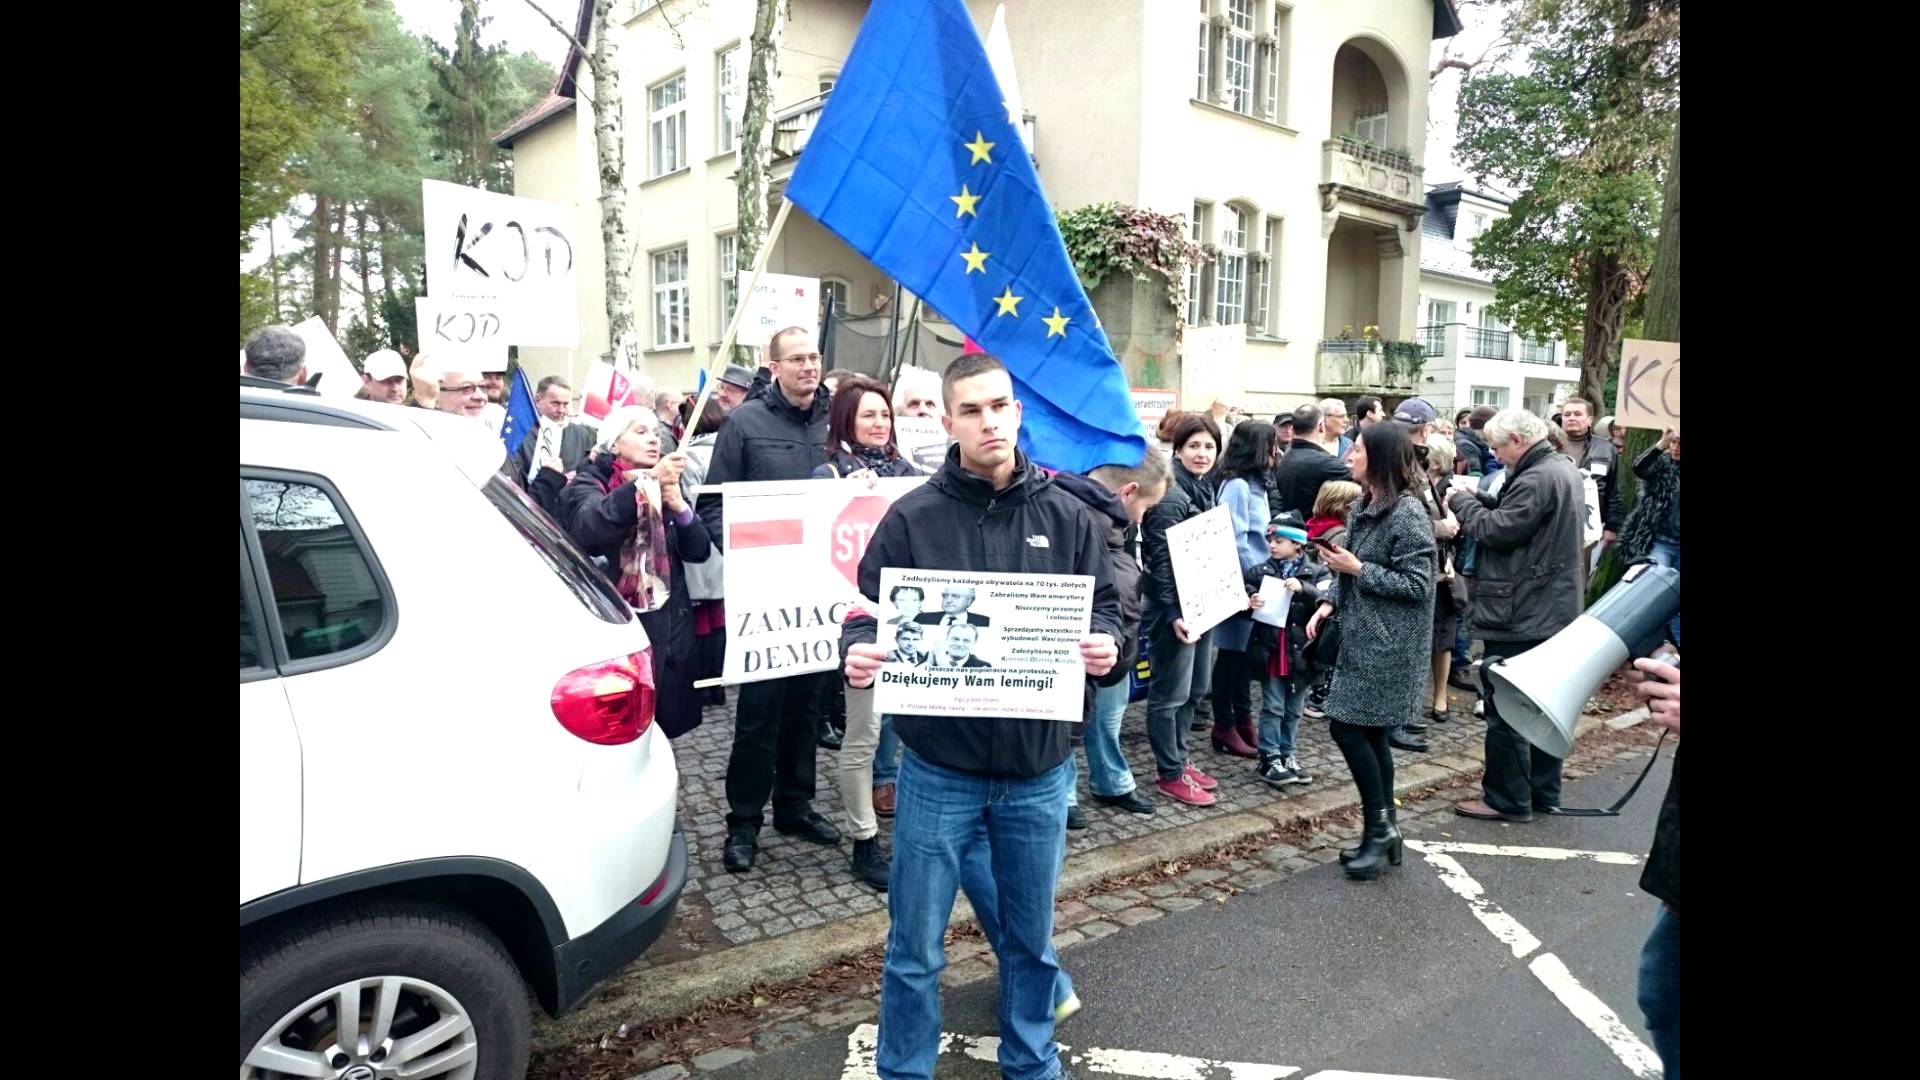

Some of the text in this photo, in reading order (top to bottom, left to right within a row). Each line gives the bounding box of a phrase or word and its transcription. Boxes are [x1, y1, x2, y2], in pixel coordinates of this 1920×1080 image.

[836, 522, 880, 562] ST
[952, 577, 984, 586] każdego
[1015, 604, 1051, 612] Niszczymy
[737, 601, 855, 637] ZAMAC
[1003, 626, 1044, 634] Sprzedajemy
[1045, 627, 1073, 635] wszystko
[743, 637, 842, 673] DEMO
[882, 671, 1054, 691] Dziękujemy Wam lemingi!
